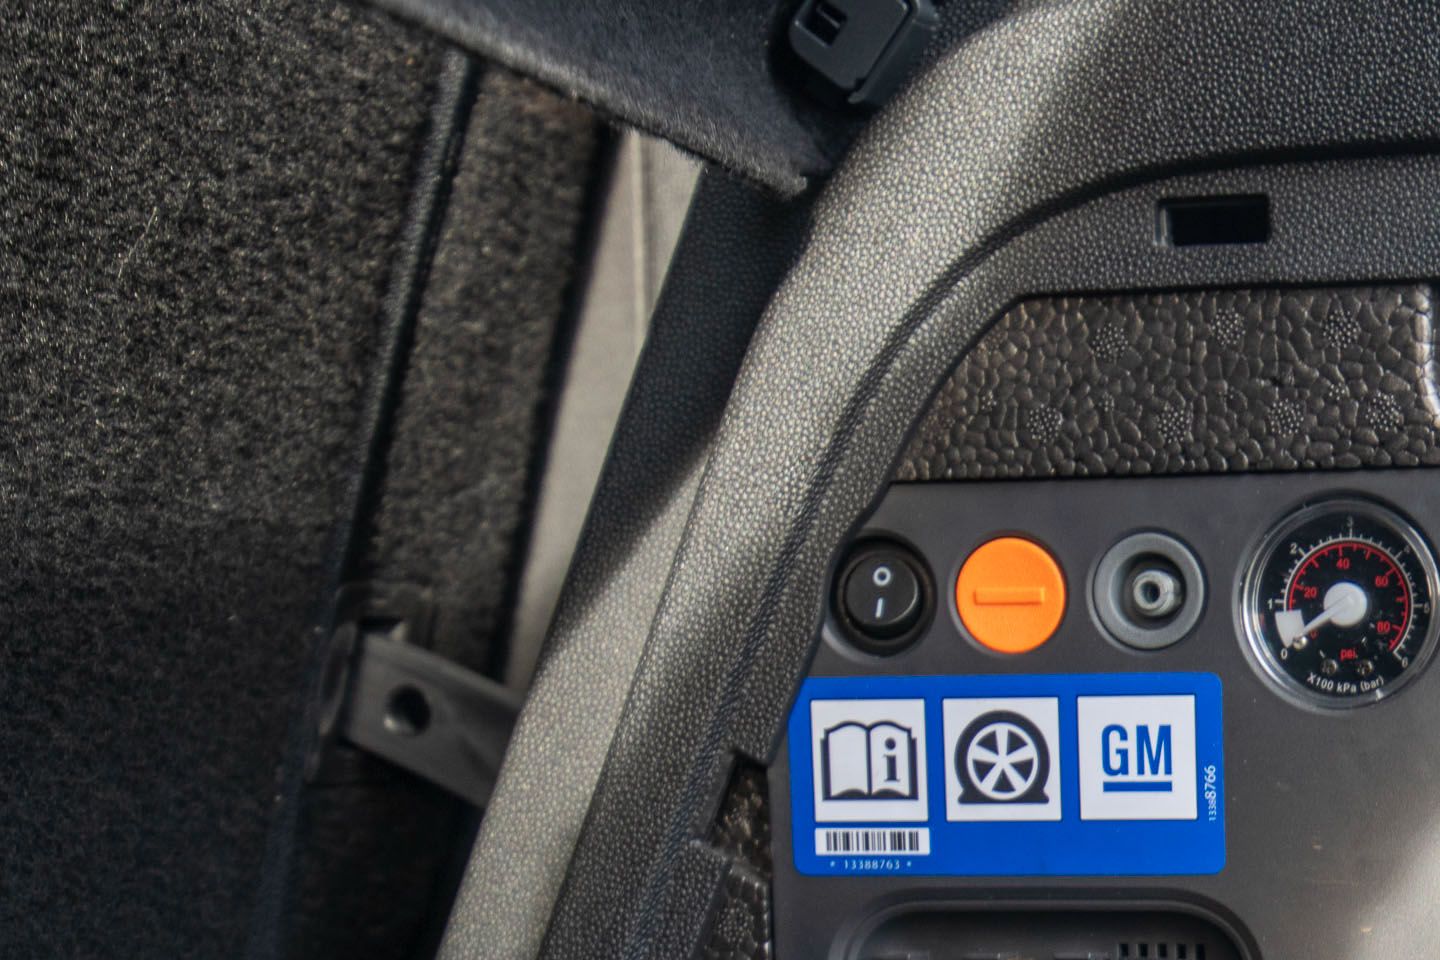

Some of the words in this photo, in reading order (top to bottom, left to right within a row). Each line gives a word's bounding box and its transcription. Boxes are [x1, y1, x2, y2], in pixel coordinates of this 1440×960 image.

[1290, 542, 1298, 554] 2
[1336, 558, 1350, 570] 40
[1304, 586, 1317, 598] 20
[1280, 648, 1288, 660] 0
[1336, 680, 1357, 693] kPa
[1360, 675, 1385, 693] (bar)
[1101, 724, 1173, 777] GM
